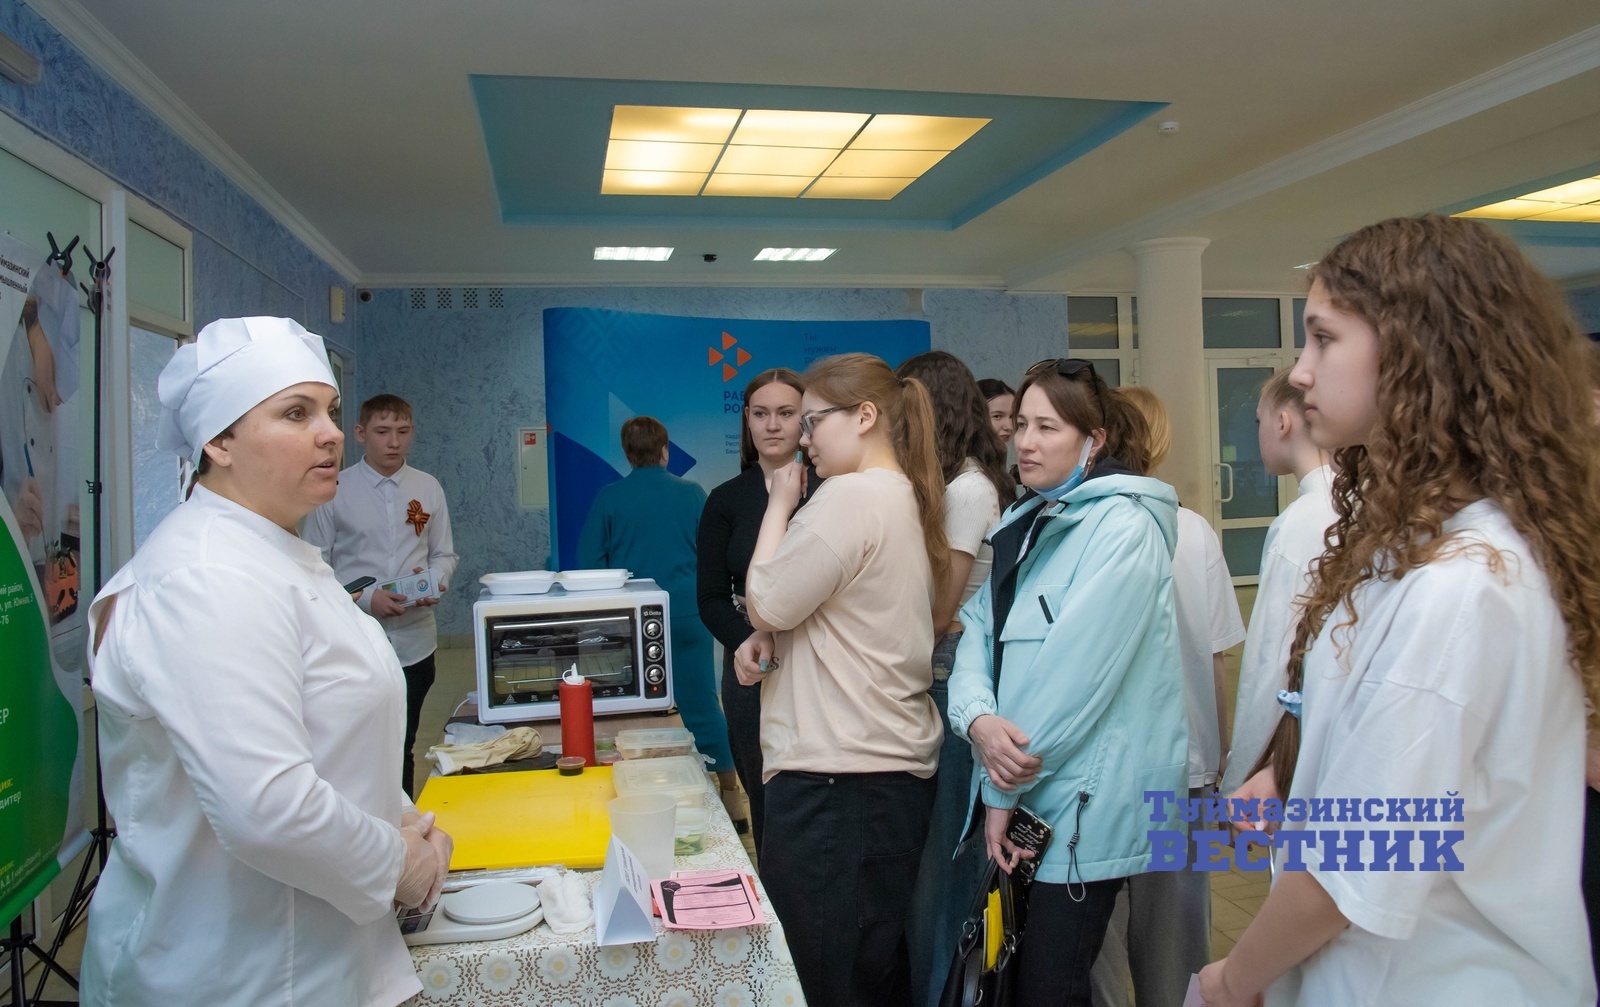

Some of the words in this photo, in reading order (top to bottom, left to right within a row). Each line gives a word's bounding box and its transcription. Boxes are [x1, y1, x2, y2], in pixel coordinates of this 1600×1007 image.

[804, 332, 817, 341] Ты
[804, 346, 837, 354] нужен
[723, 403, 744, 414] РО
